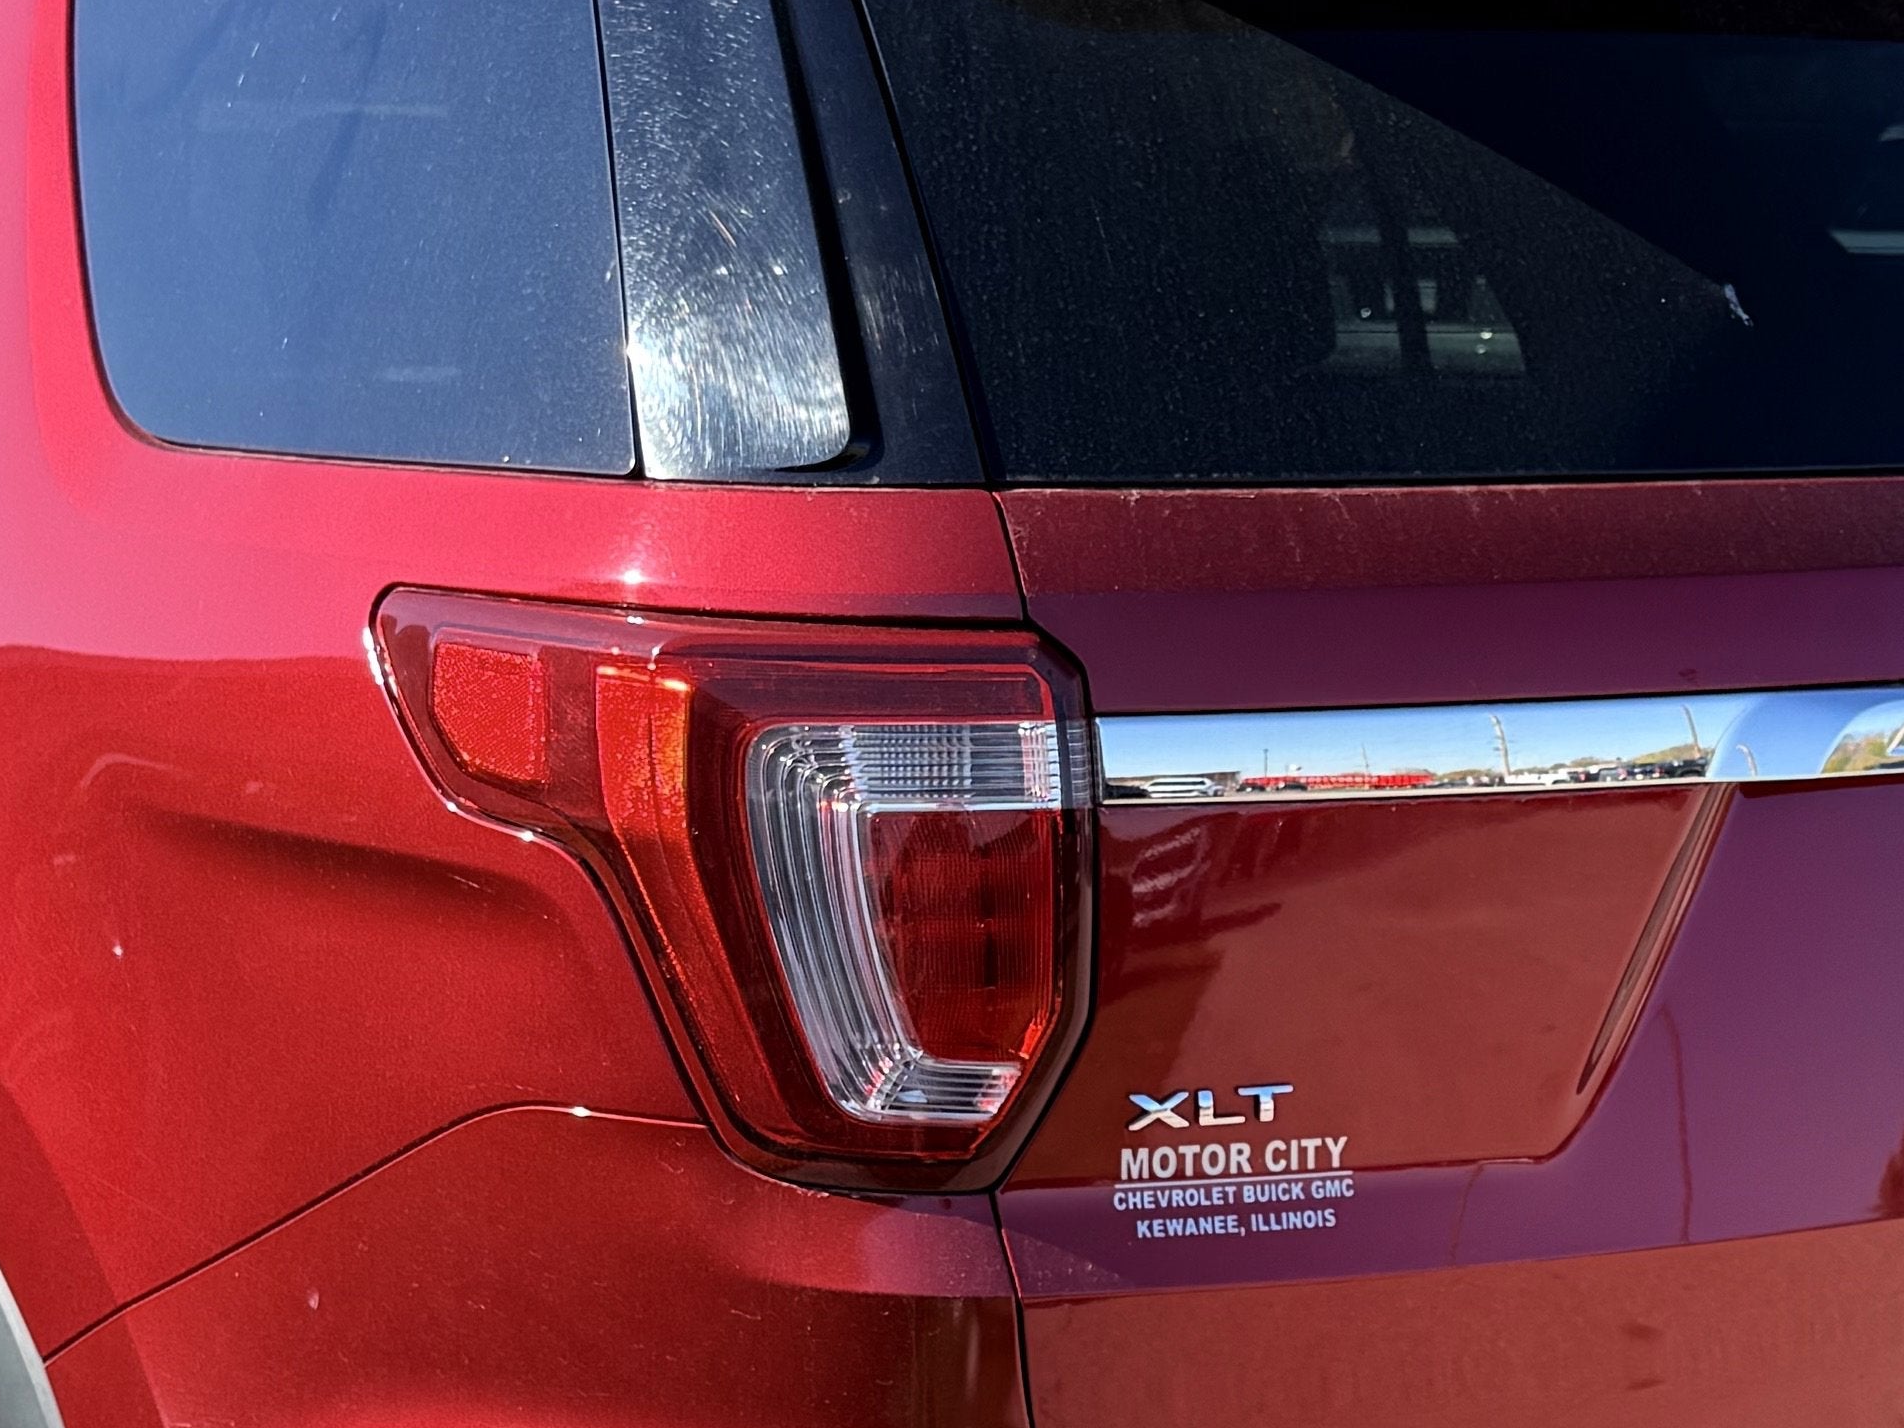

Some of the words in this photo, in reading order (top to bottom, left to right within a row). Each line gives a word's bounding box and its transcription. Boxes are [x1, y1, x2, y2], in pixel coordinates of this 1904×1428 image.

[1127, 1083, 1294, 1132] XLT
[1120, 1142, 1253, 1181] MOTOR
[1264, 1136, 1348, 1172] CITY
[1113, 1186, 1237, 1211] CHEVROLET
[1242, 1181, 1305, 1204] BUICK
[1310, 1178, 1355, 1200] GMC
[1136, 1214, 1247, 1239] KEWANEE,
[1251, 1208, 1336, 1233] ILLINOIS
